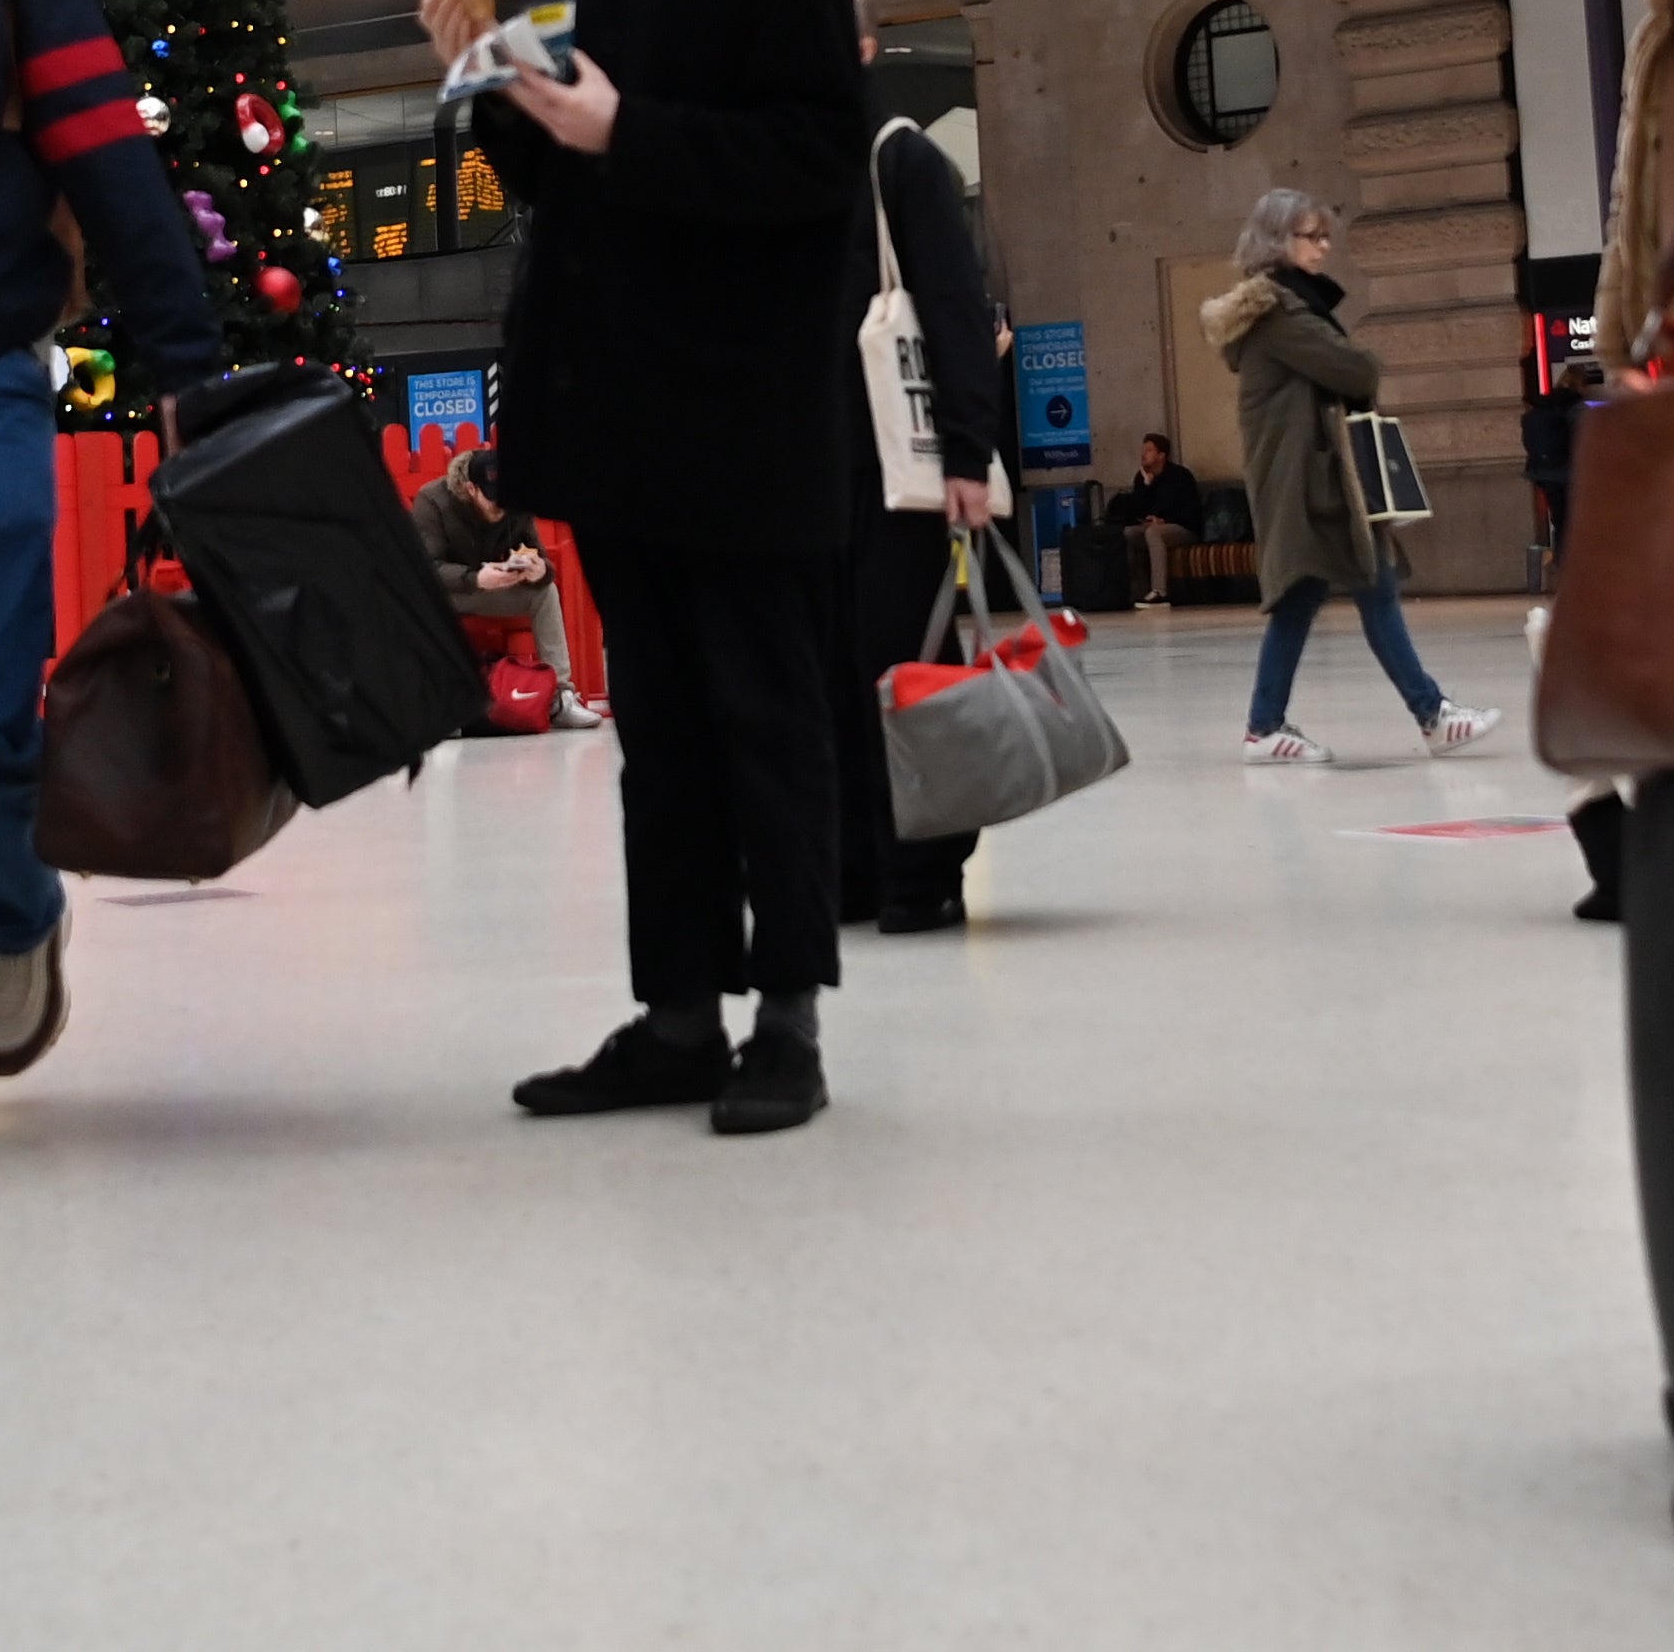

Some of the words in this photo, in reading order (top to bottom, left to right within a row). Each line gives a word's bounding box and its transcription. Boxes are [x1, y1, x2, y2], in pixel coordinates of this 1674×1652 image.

[415, 380, 433, 389] THIS
[436, 377, 464, 387] STORE
[467, 376, 476, 385] IS
[414, 388, 476, 401] TEMPORARILY
[414, 398, 477, 417] CLOSED
